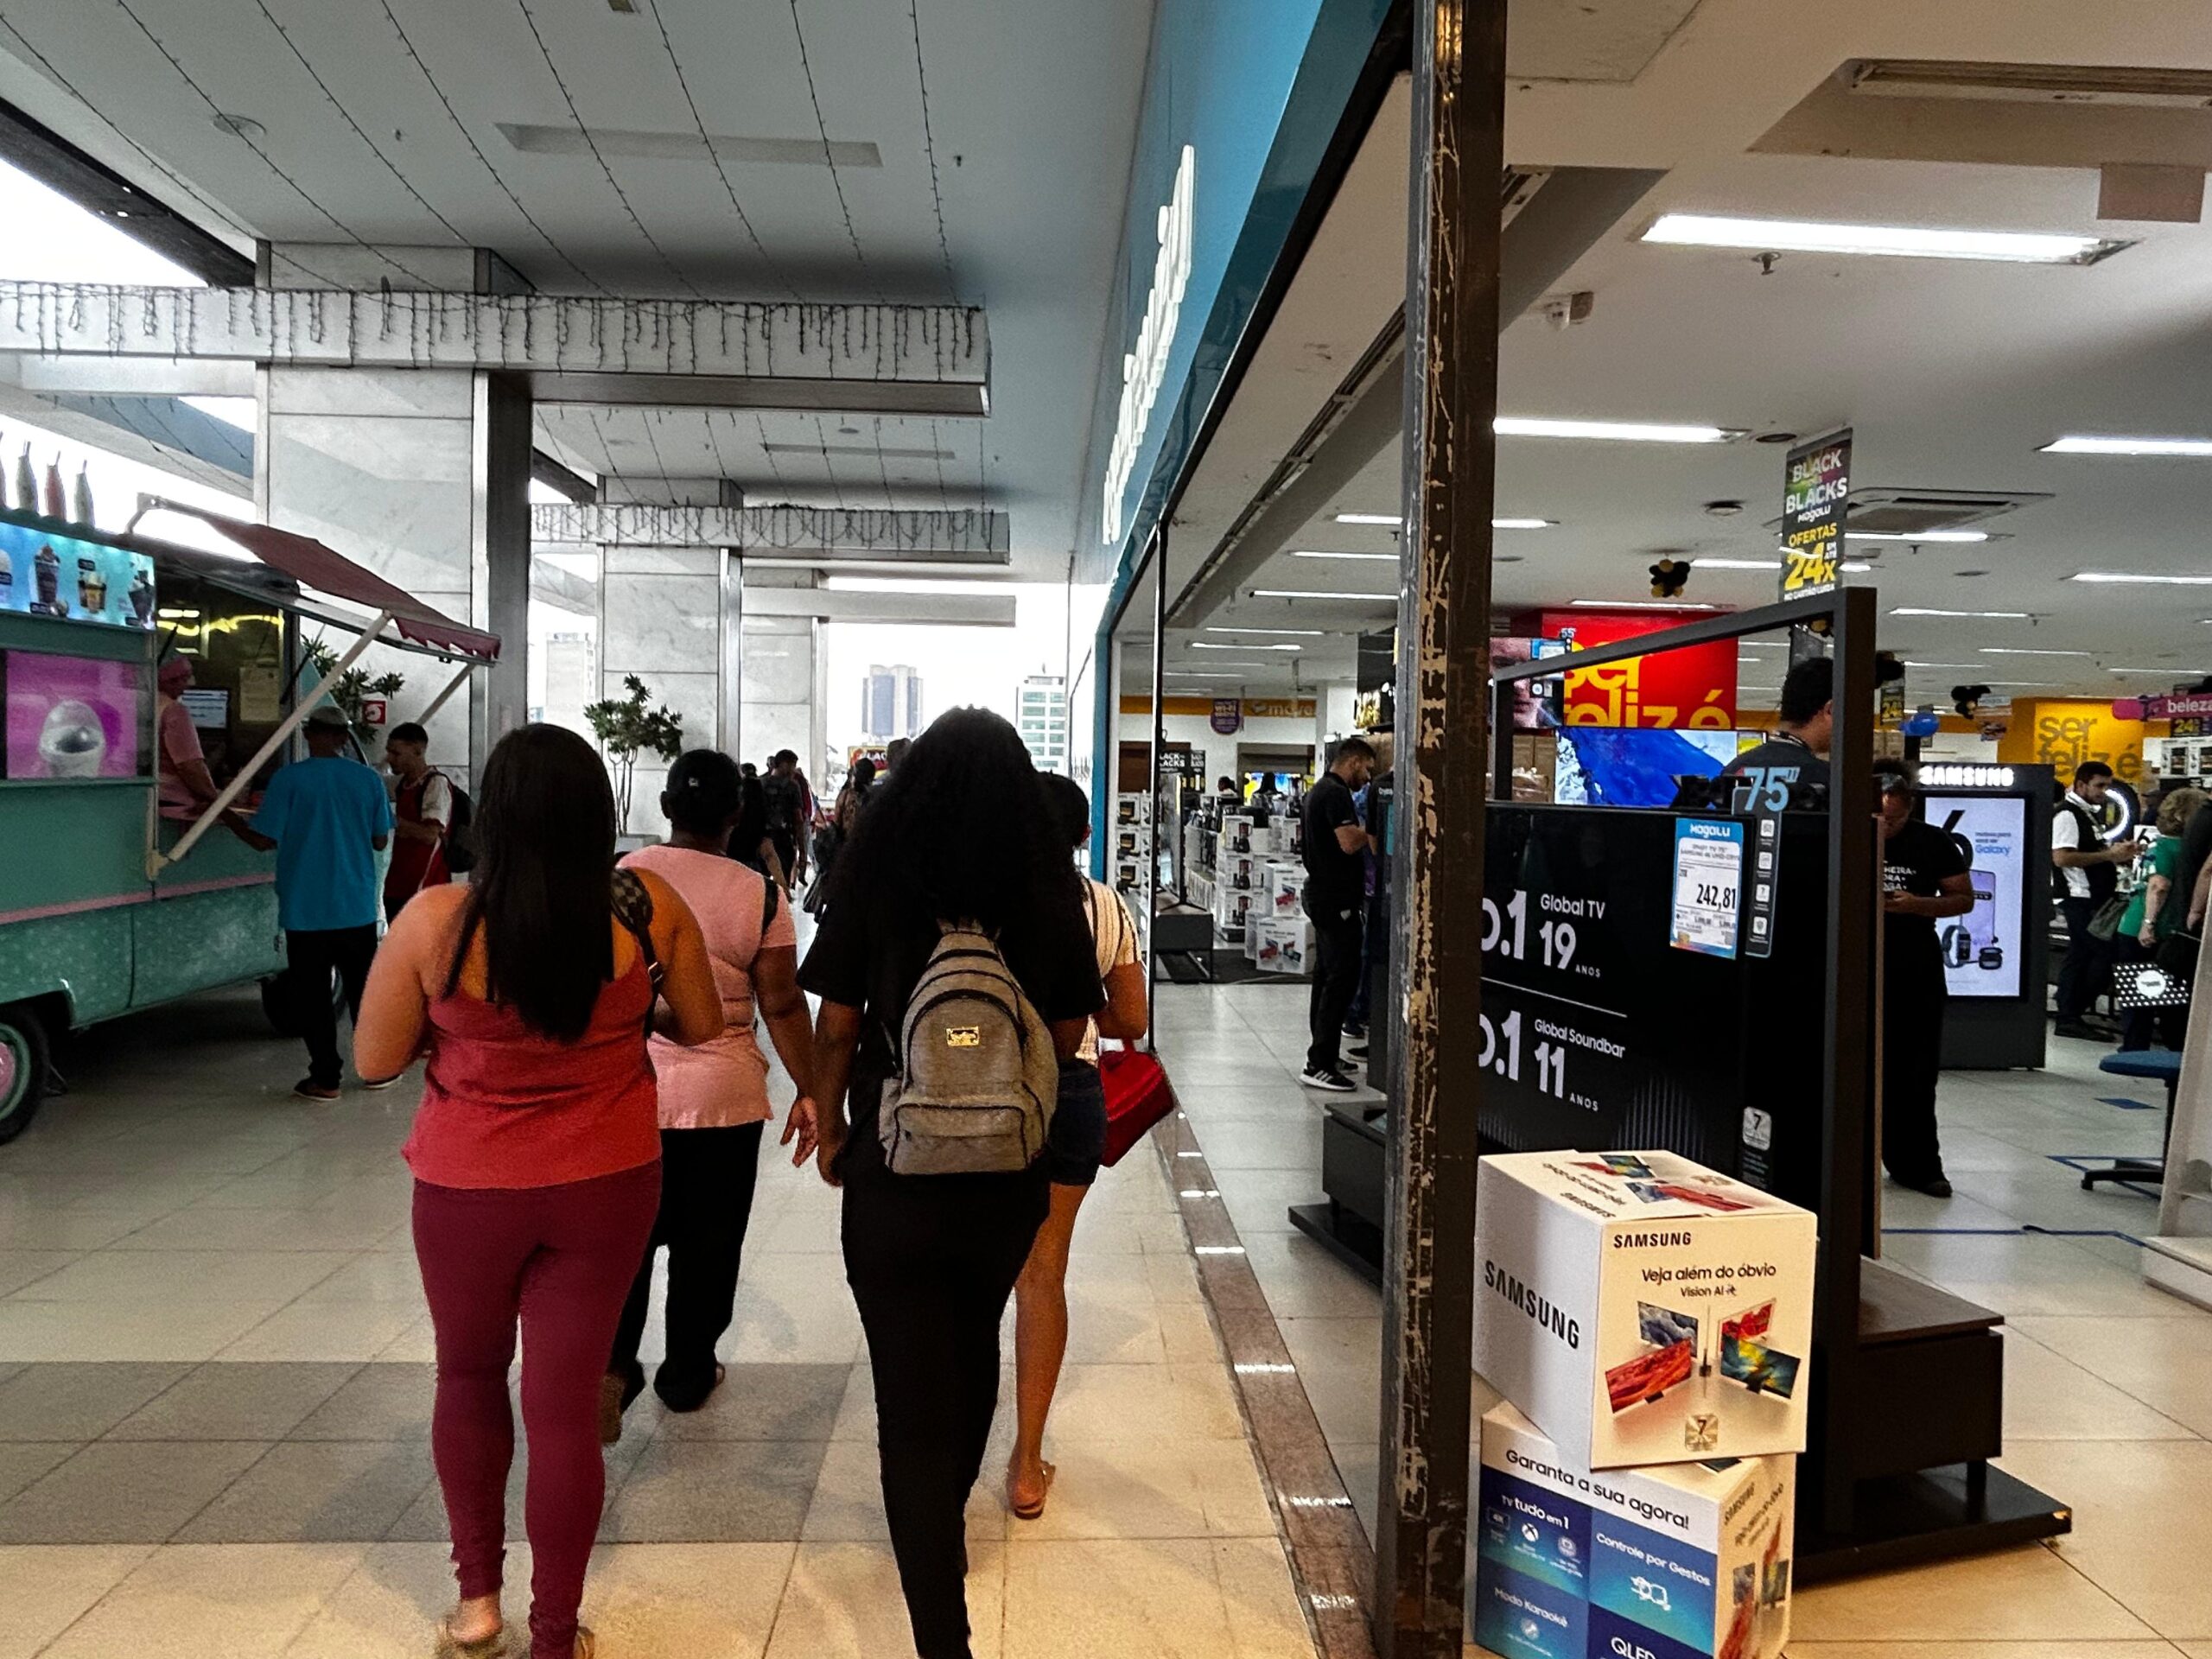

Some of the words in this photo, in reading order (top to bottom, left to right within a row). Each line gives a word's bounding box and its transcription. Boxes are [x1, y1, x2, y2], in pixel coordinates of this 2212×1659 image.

[1793, 449, 1842, 483] BLACK
[1785, 477, 1847, 515] BLACKS
[1788, 523, 1837, 548] OFERTAS
[2038, 716, 2098, 743] ser
[2117, 743, 2142, 778] é
[1918, 766, 2014, 786] SAMSUNG
[1540, 893, 1583, 917] Global
[1587, 900, 1605, 919] TV
[1696, 883, 1736, 912] 242,81
[1539, 920, 1577, 970] 19
[1575, 964, 1601, 978] ANOS
[1534, 1019, 1568, 1042] Global
[1568, 1029, 1625, 1059] Soundbar
[1534, 1041, 1565, 1099] 11
[1569, 1092, 1599, 1112] ANOS
[1613, 1231, 1692, 1249] SAMSUNG
[1642, 1266, 1672, 1286] Veja
[1675, 1264, 1712, 1281] além
[1715, 1264, 1734, 1279] do
[1738, 1262, 1777, 1277] óbvio
[1484, 1259, 1580, 1350] SAMSUNG
[1680, 1287, 1712, 1297] Vision
[1697, 1419, 1707, 1435] 7
[1506, 1449, 1574, 1486] Garanta
[1578, 1479, 1590, 1492] a
[1593, 1484, 1625, 1504] sua
[1629, 1497, 1689, 1530] agora!
[1514, 1497, 1546, 1520] tudo
[1546, 1514, 1563, 1528] em
[1596, 1533, 1644, 1560] Controle
[1645, 1553, 1668, 1568] por
[1669, 1562, 1712, 1586] Gestos
[1494, 1586, 1523, 1608] Modo
